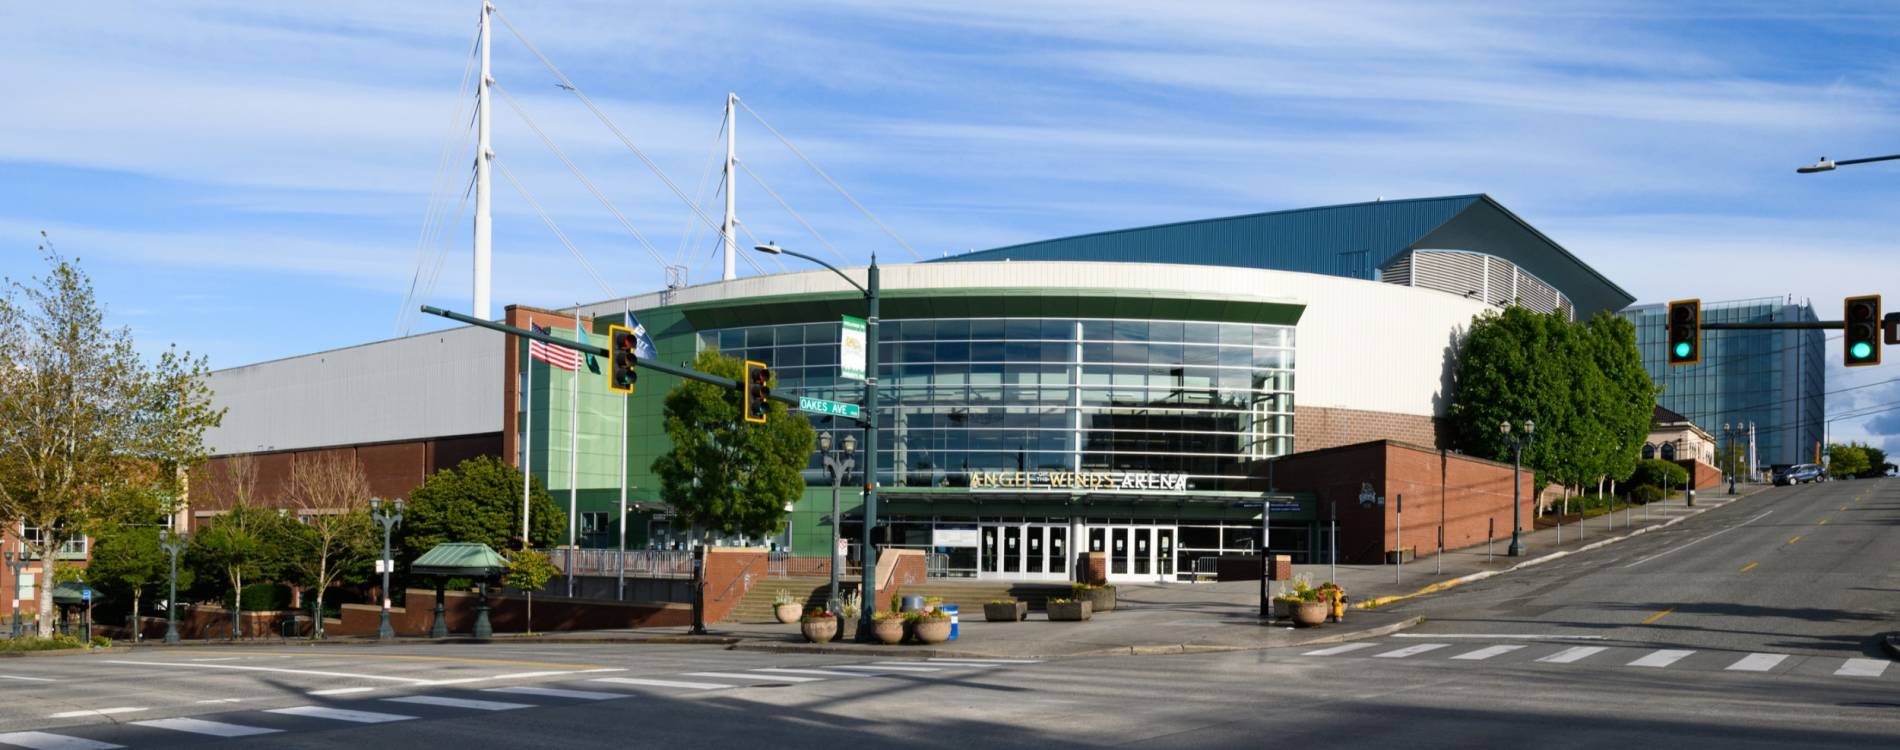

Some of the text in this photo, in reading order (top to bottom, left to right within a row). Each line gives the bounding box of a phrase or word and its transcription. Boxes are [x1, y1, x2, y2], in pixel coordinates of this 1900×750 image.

[801, 399, 828, 411] OAKES
[832, 403, 847, 415] AVE
[970, 471, 1035, 488] ANGEL
[1050, 472, 1114, 488] WINDS
[1121, 473, 1186, 491] ARENA
